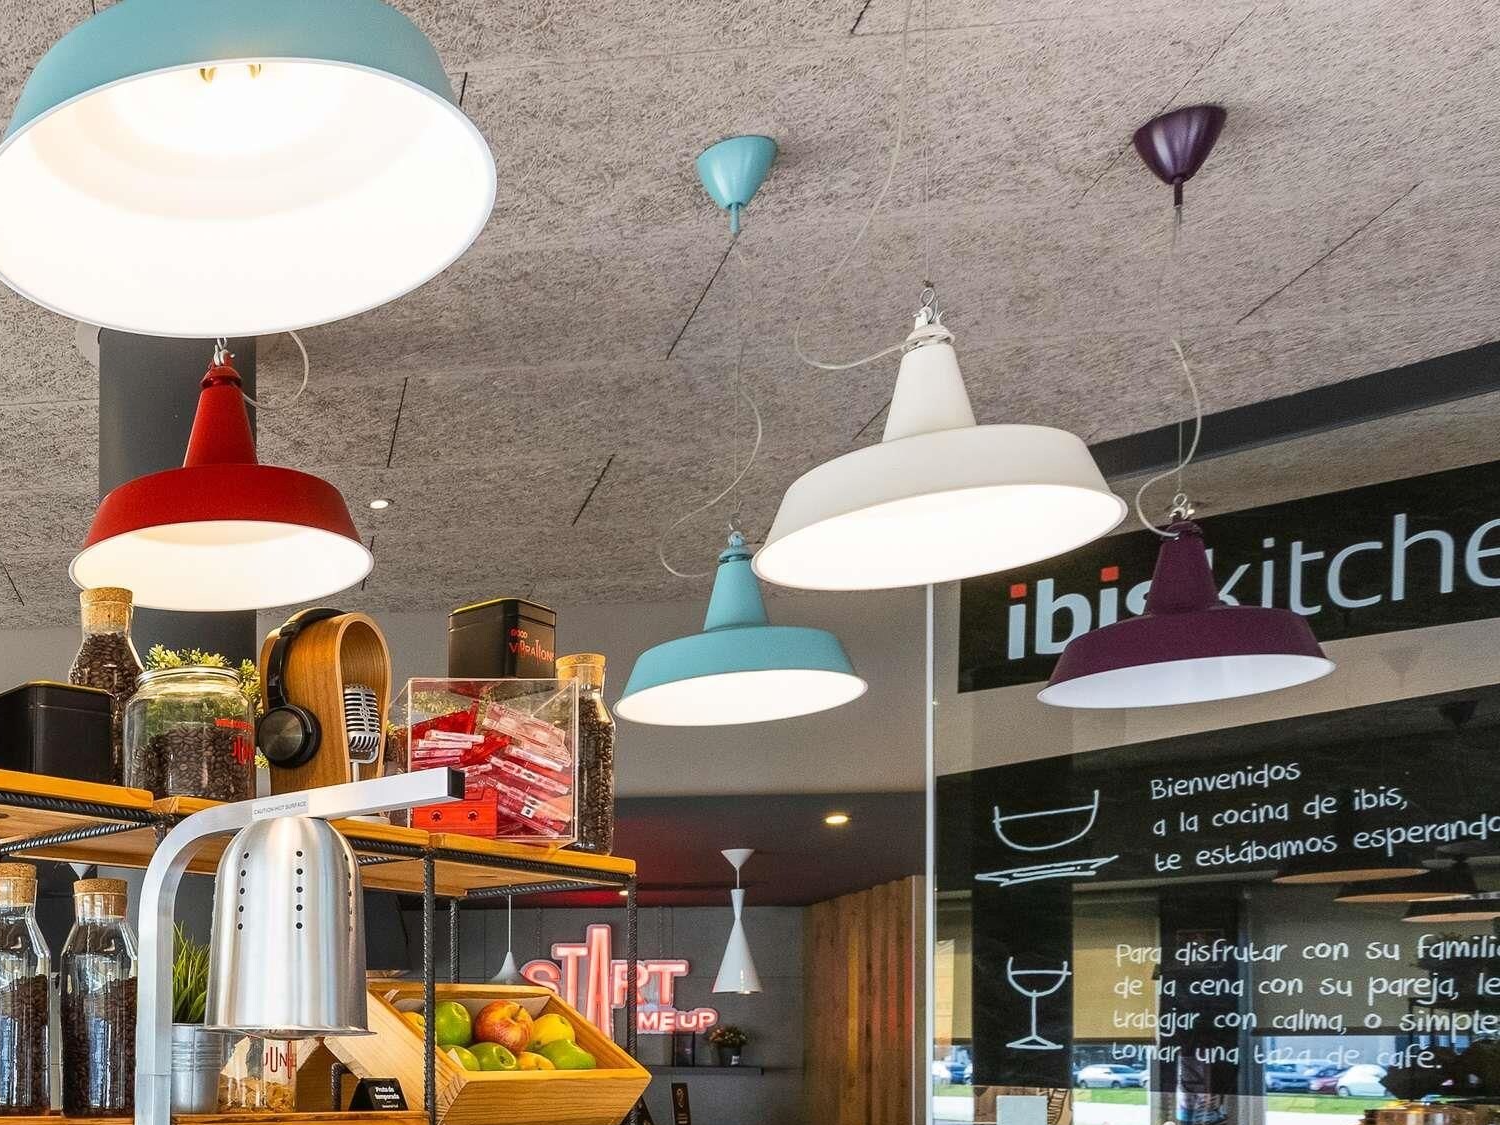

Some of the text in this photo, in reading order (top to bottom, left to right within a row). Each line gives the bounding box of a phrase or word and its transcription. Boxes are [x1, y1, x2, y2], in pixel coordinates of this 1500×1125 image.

[1151, 762, 1301, 799] Bienvenidos
[1153, 786, 1408, 836] a la cocina de ibis,
[1155, 853, 1182, 872] te
[1195, 834, 1337, 867] estábamos
[1116, 943, 1162, 967] Para
[1175, 938, 1288, 966] disfrutar
[1302, 942, 1349, 961] con
[1365, 941, 1400, 960] su
[1114, 976, 1143, 998] de
[1155, 975, 1176, 997] la
[1189, 978, 1244, 997] cena
[1258, 977, 1304, 996] con
[1319, 977, 1352, 997] su
[1367, 972, 1459, 1006] pareja,
[638, 1011, 676, 1032] ME
[1113, 1007, 1200, 1037] trabajar
[1214, 1012, 1257, 1030] con
[1272, 1008, 1347, 1035] calma,
[1364, 1013, 1382, 1029] o
[1112, 1042, 1442, 1069] tomar una taza de café.
